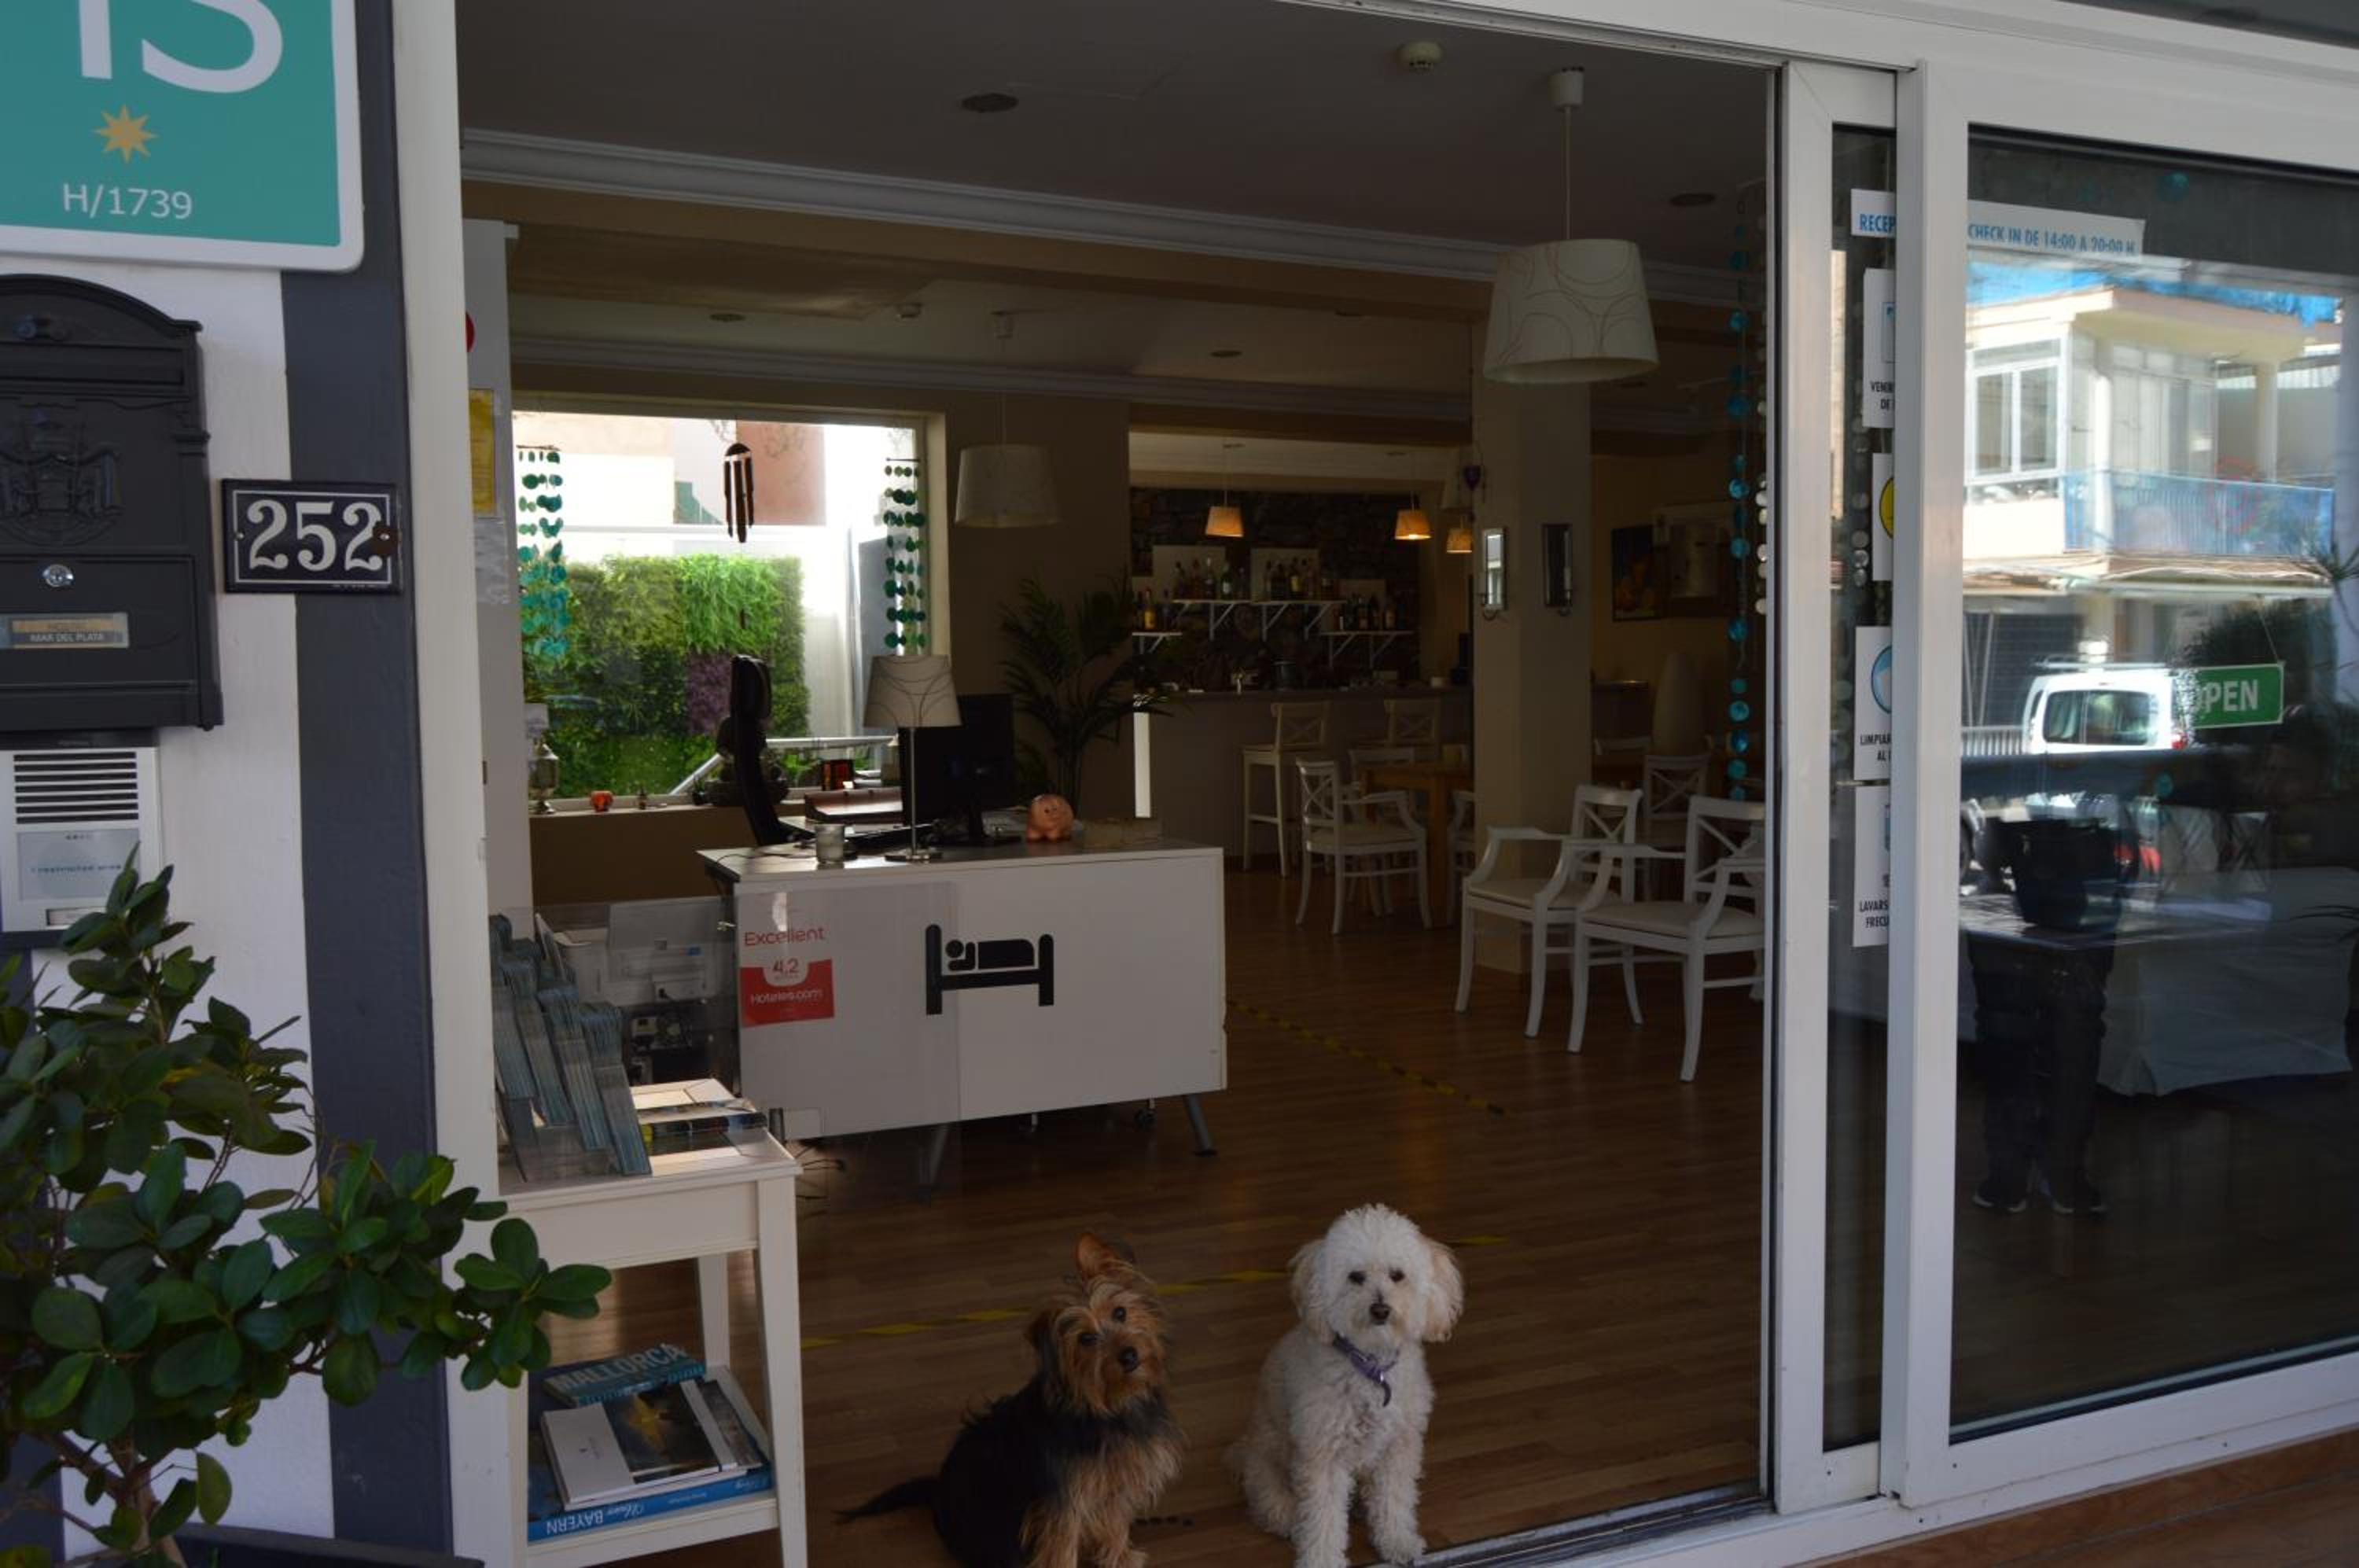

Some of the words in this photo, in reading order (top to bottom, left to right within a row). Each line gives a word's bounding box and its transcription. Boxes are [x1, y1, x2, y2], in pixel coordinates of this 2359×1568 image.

[63, 182, 193, 220] H/1739
[1968, 223, 2004, 242] CHECK
[2008, 227, 2022, 243] IN
[2025, 229, 2039, 247] DE
[2043, 231, 2077, 251] 14:00
[2079, 235, 2088, 252] A
[246, 499, 383, 572] 252
[744, 927, 826, 947] Excellent
[547, 1510, 604, 1534] BAYERN
